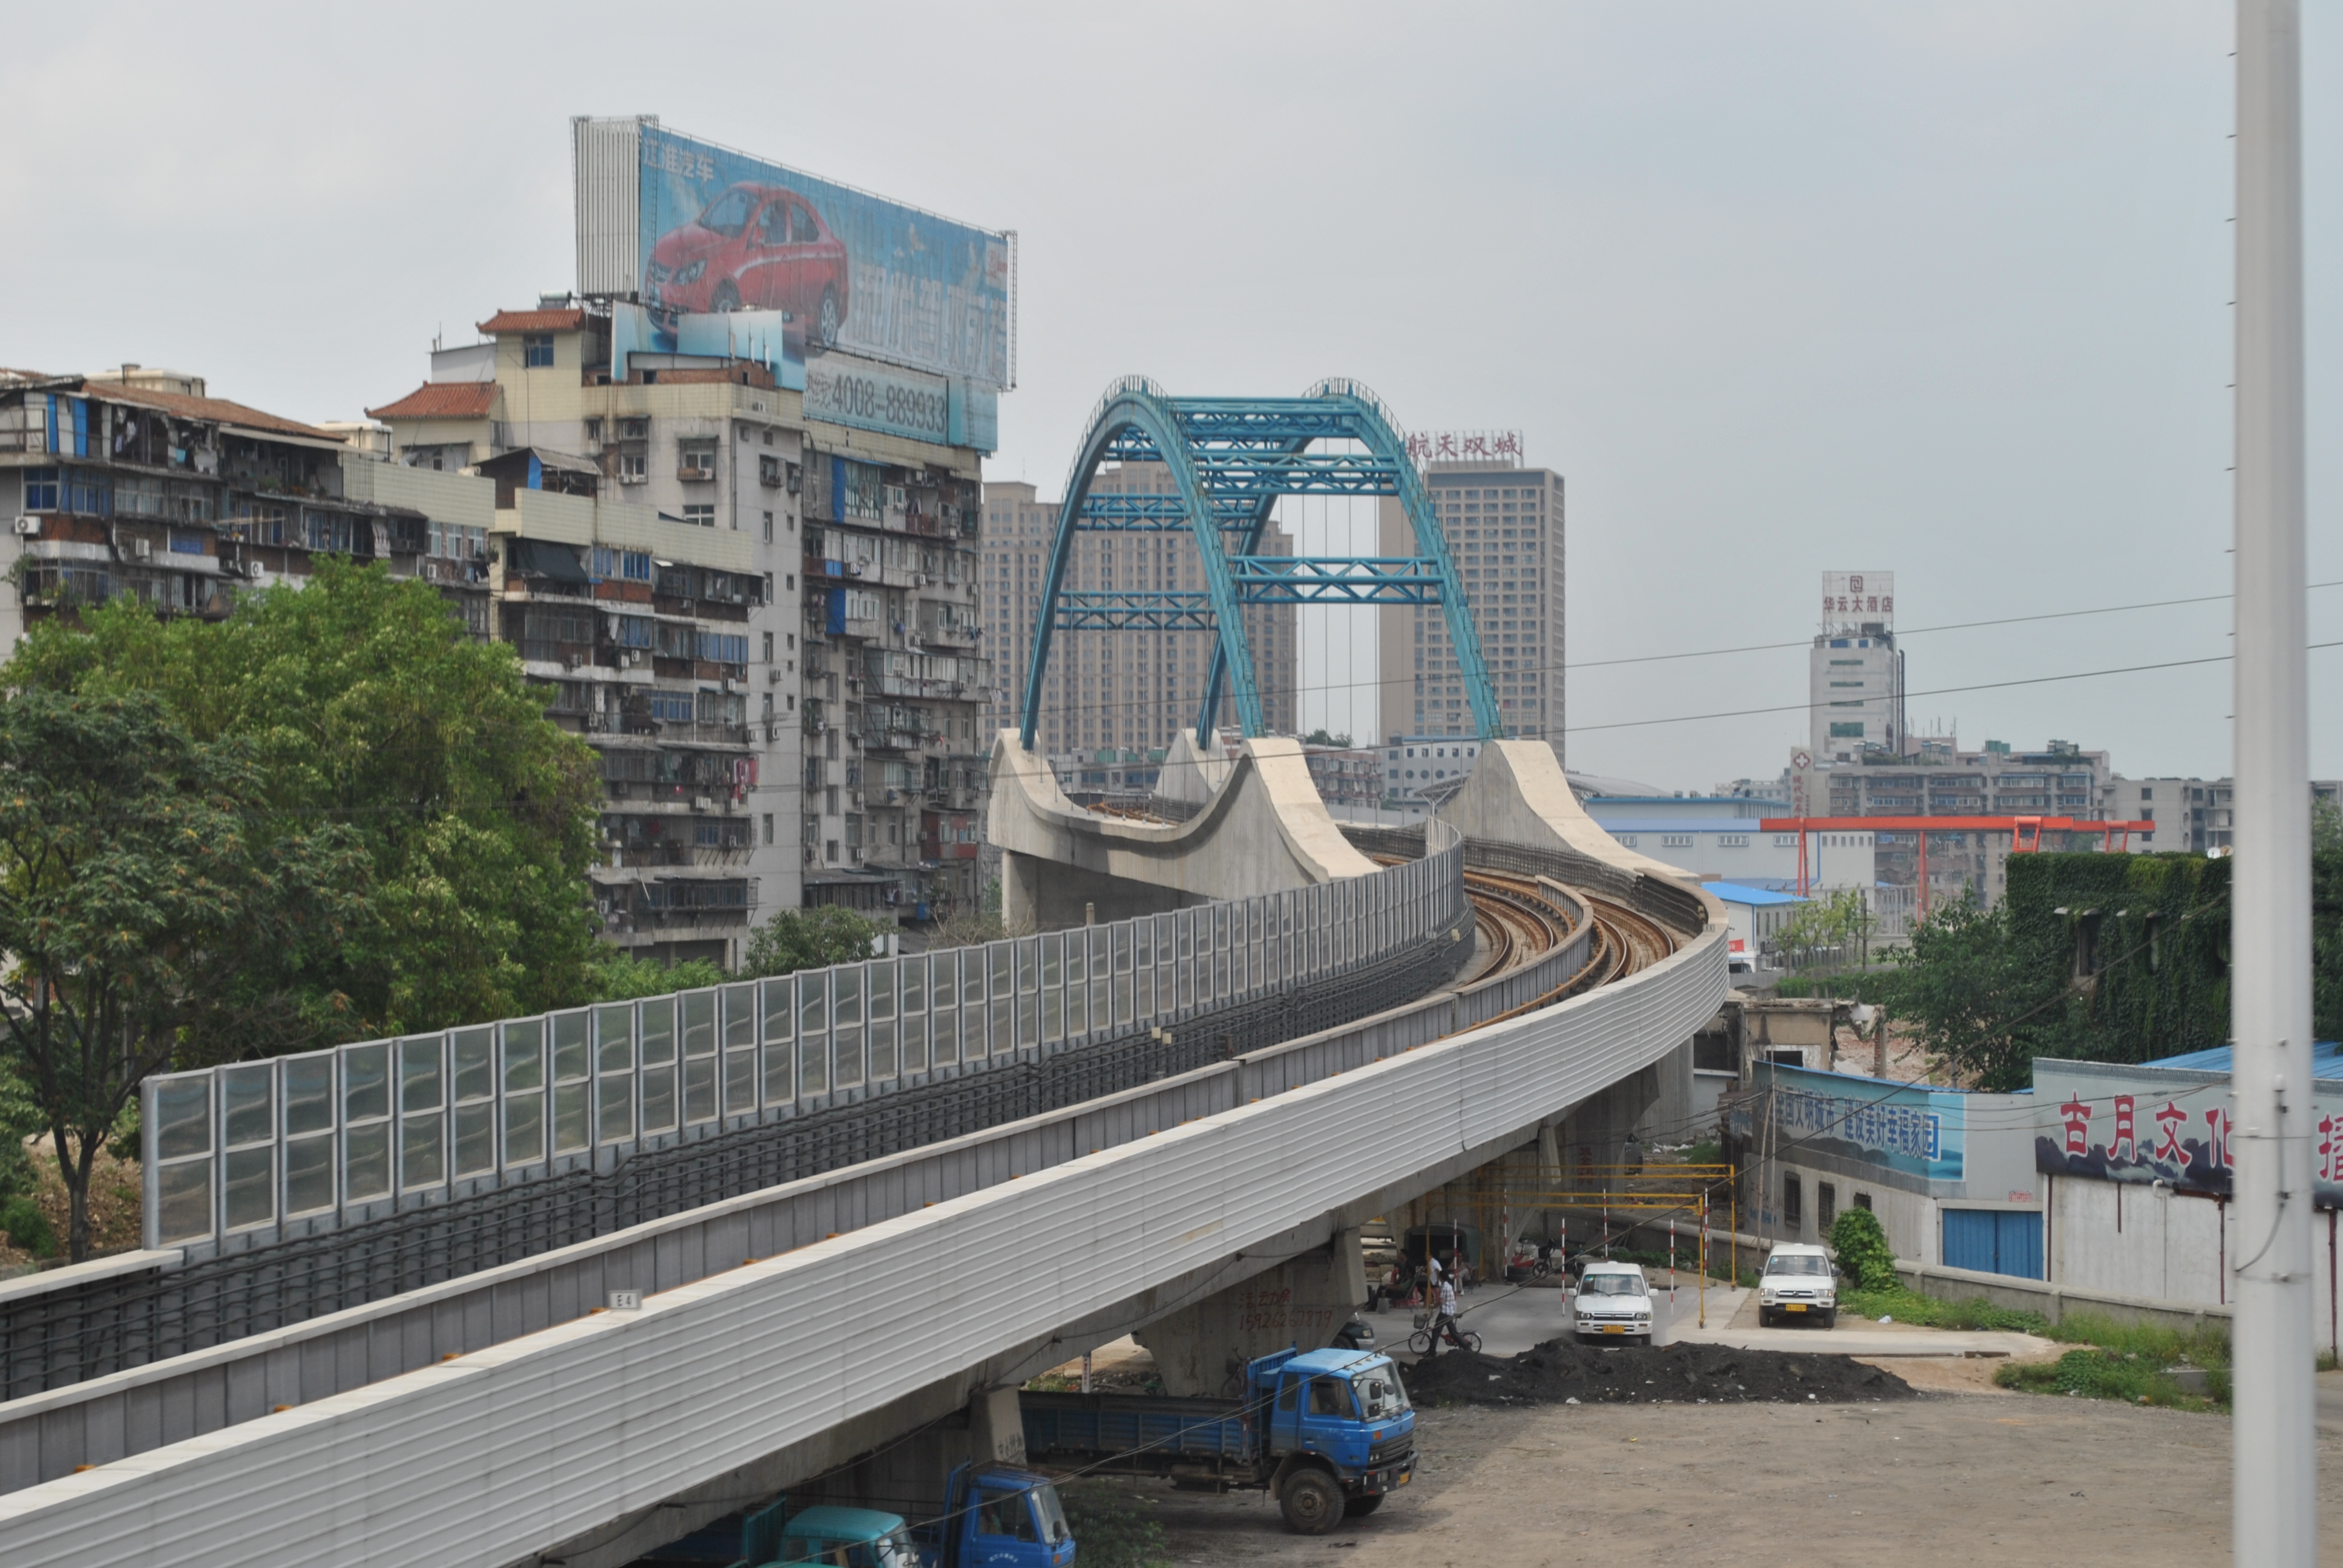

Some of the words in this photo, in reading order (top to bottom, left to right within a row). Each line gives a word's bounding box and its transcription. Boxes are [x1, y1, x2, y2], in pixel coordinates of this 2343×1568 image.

[644, 138, 715, 183] 江淮汽车
[1406, 433, 1523, 459] 航天双城
[1823, 595, 1893, 613] 华云大酒店
[1844, 1094, 1941, 1161] 建设美好幸福家园
[617, 1294, 632, 1307] E4
